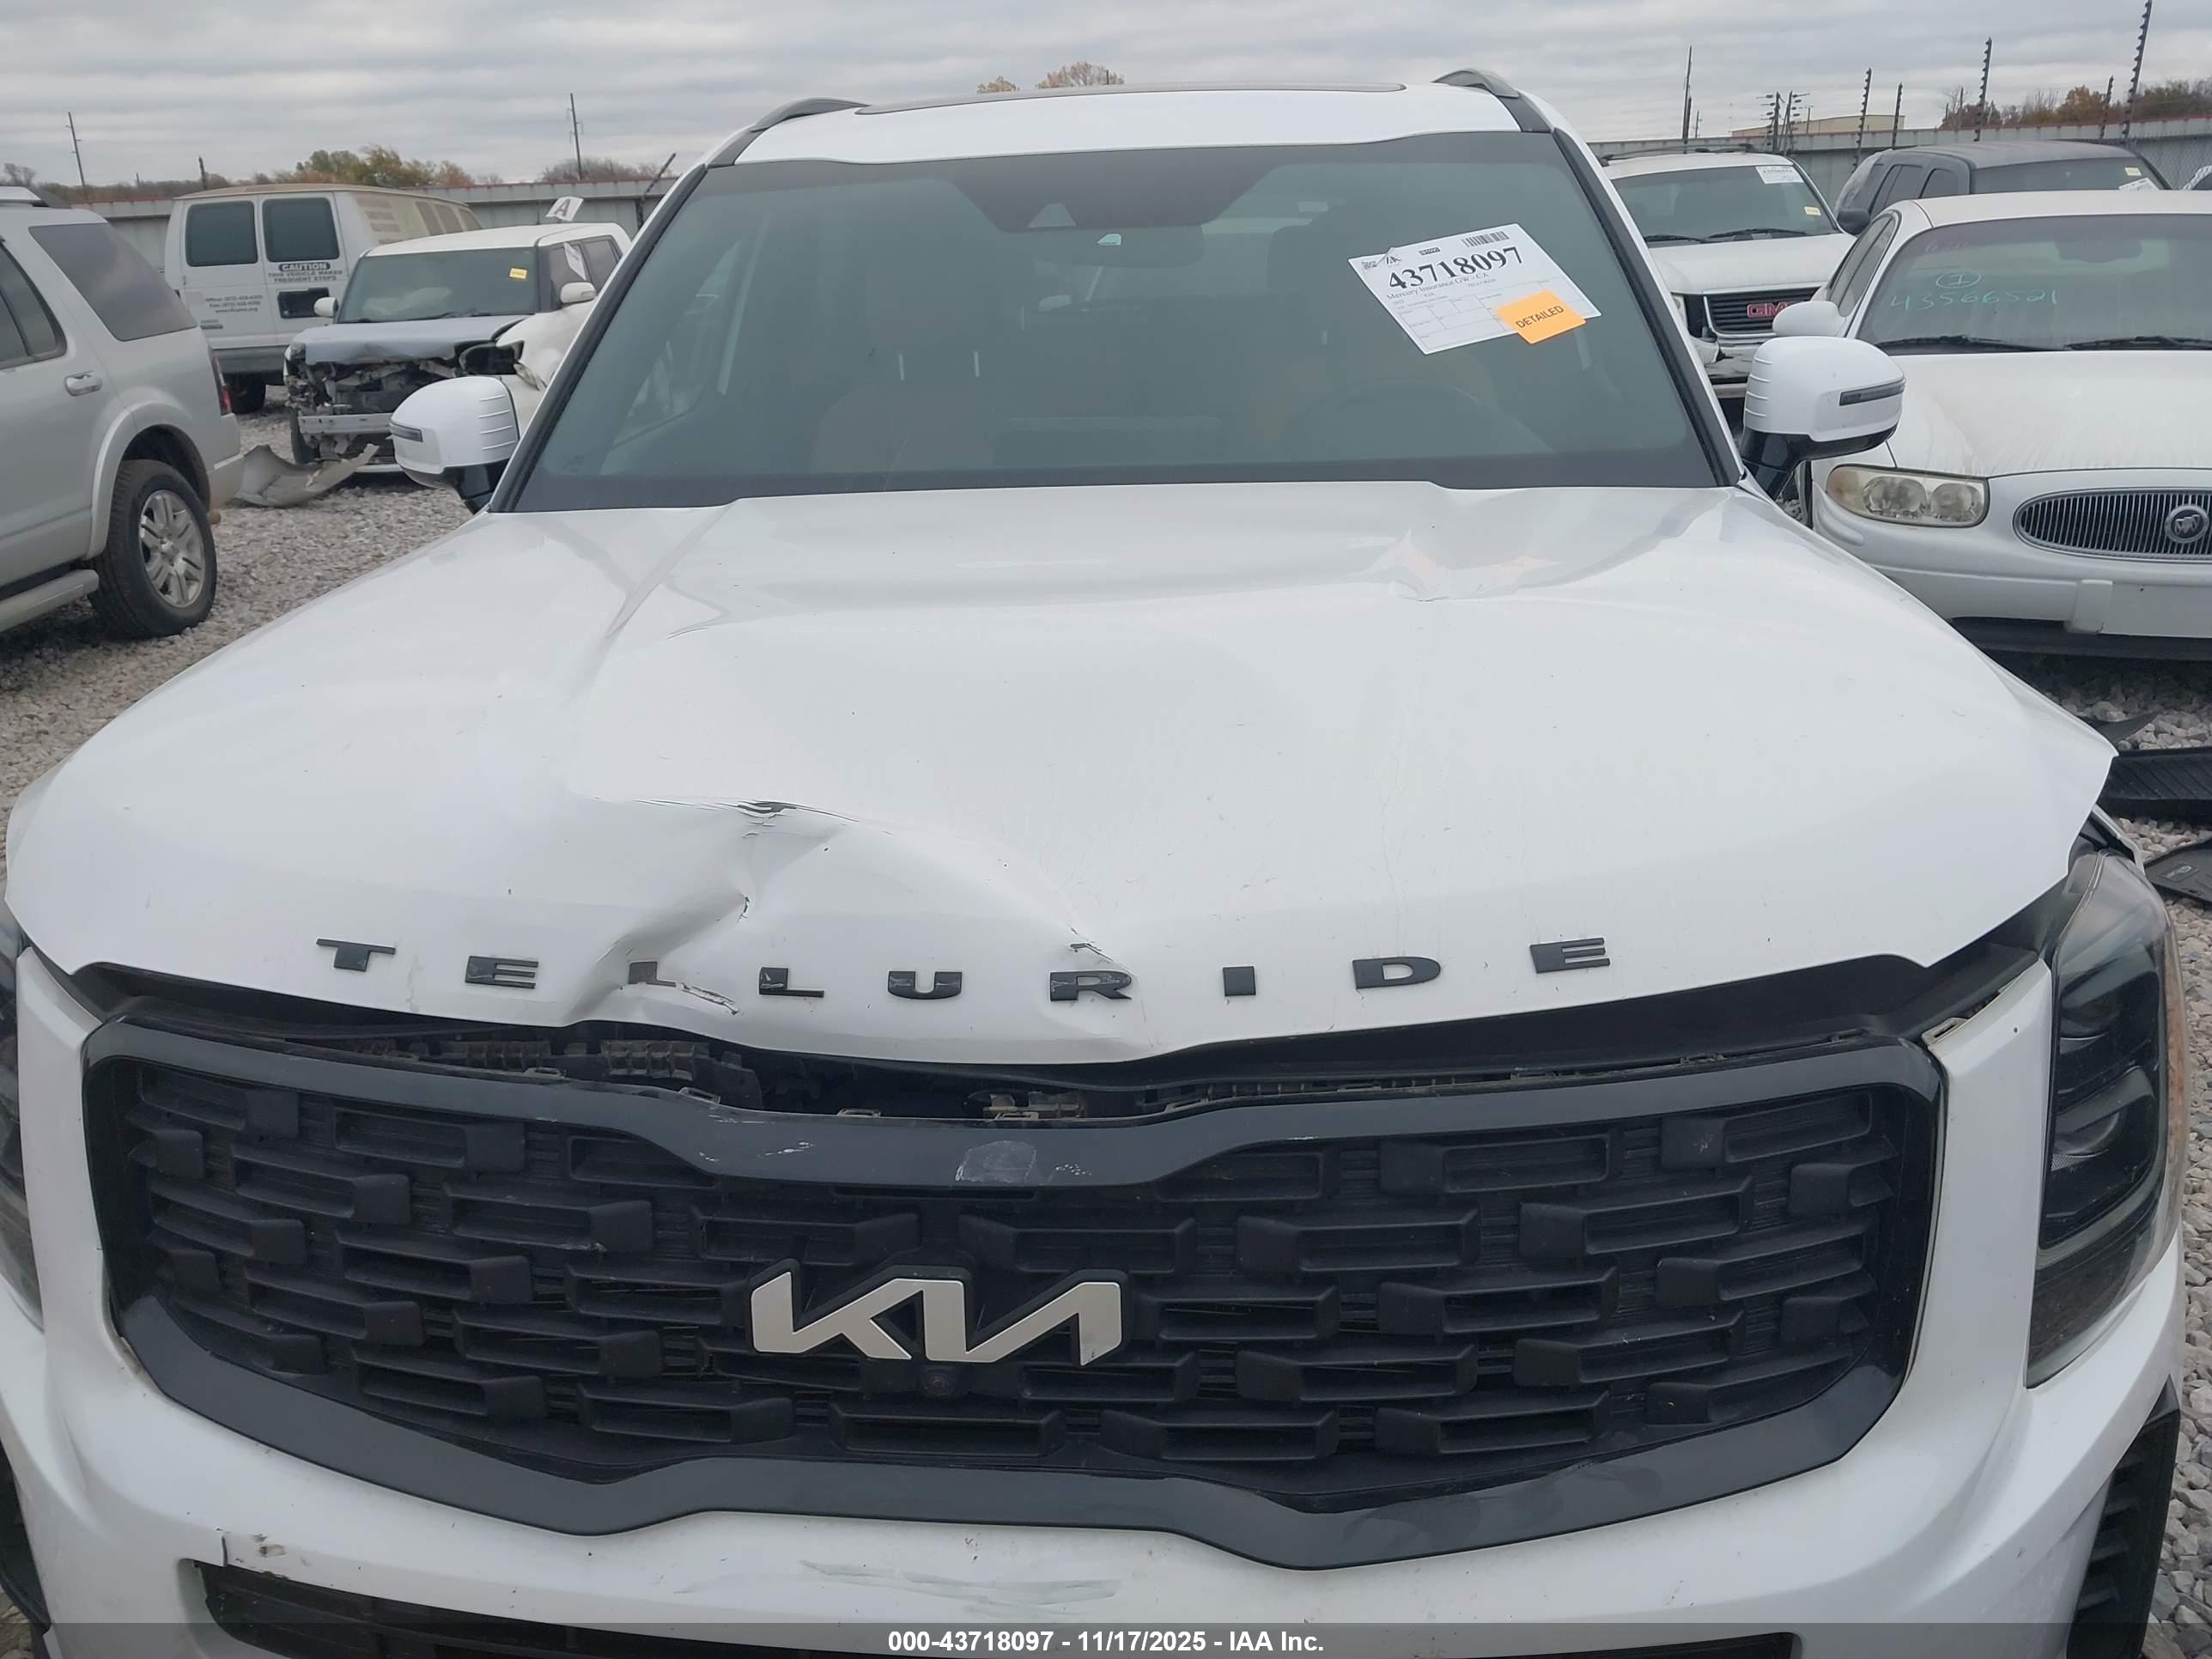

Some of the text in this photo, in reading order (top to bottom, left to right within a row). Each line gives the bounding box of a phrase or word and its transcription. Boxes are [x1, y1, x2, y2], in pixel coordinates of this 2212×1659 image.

[554, 198, 571, 217] A
[282, 263, 327, 271] CAUTION
[1389, 246, 1522, 289] 43718097
[1386, 289, 1419, 301] Mercury
[1516, 305, 1565, 328] DETAILED
[1747, 301, 1788, 318] GM
[751, 1271, 1121, 1365] KIA
